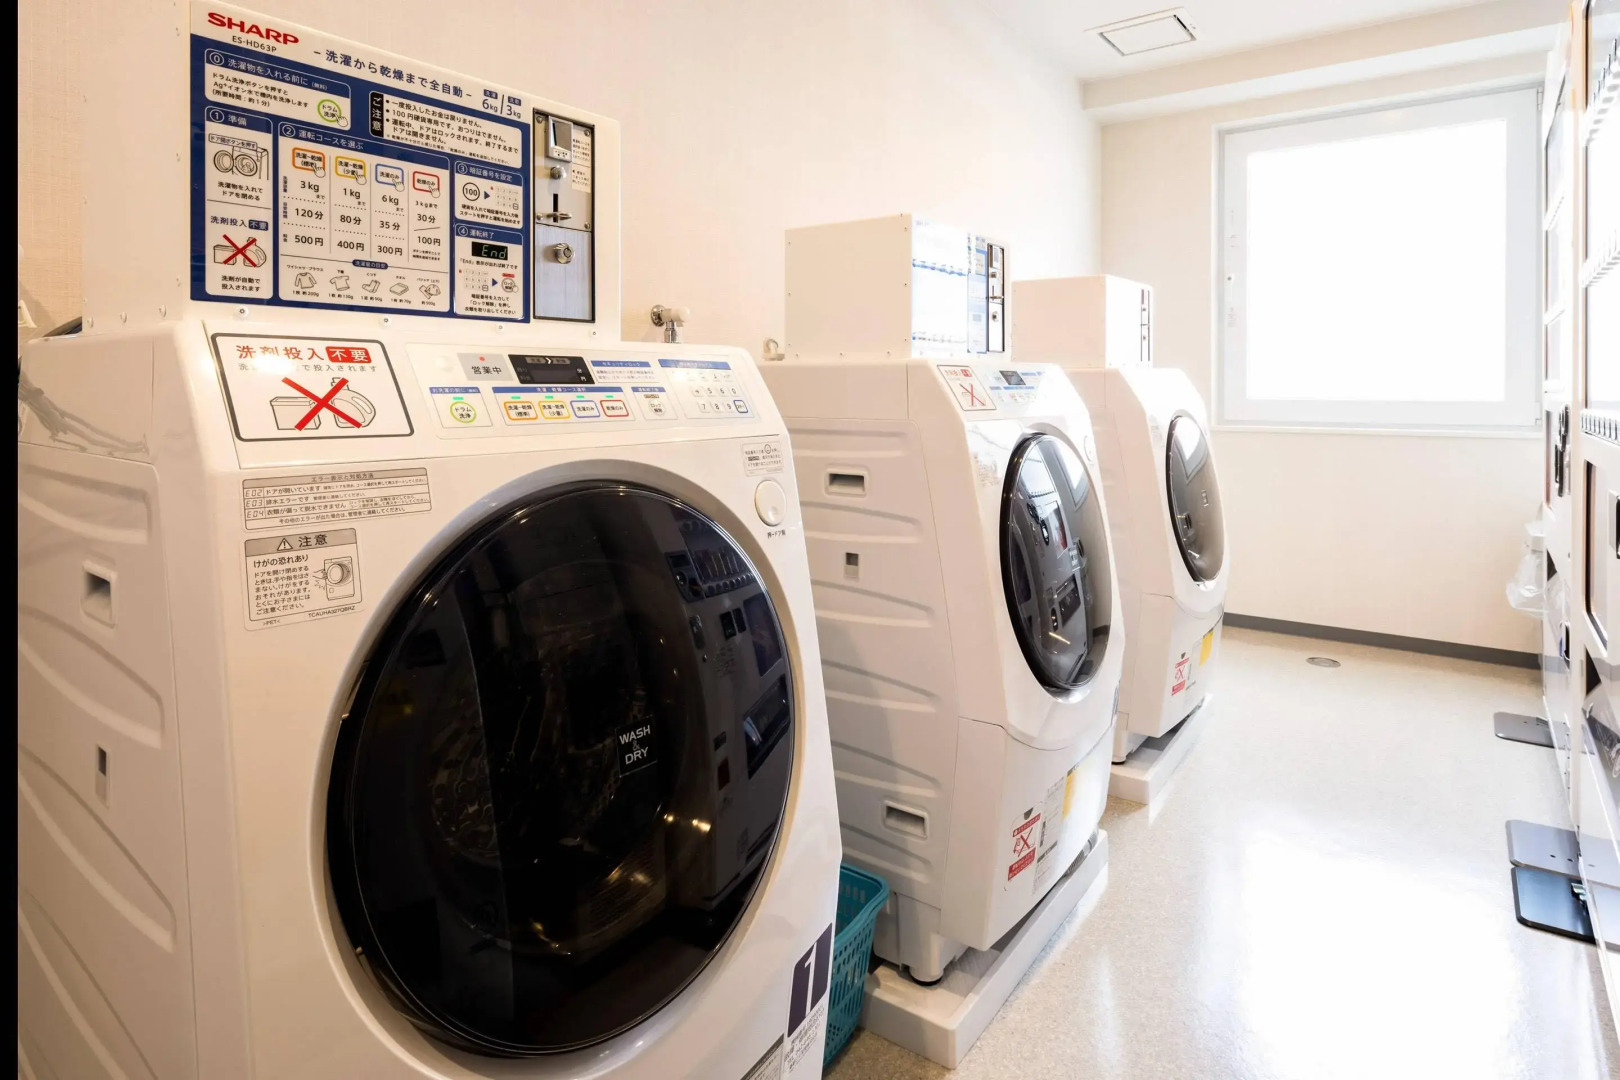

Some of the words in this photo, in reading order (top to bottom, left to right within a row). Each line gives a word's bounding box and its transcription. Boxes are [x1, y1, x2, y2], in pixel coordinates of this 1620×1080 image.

[208, 12, 299, 45] SHARP
[232, 35, 277, 53] ES-HD63P
[227, 58, 309, 85] 洗濯物を入れる前に
[482, 98, 498, 113] 6kg
[506, 105, 521, 119] 3kg
[228, 114, 247, 126] 準備
[298, 129, 364, 150] 運転コースを選ぶ
[469, 166, 513, 182] 暗証番号を設定
[218, 181, 263, 193] 洗濯物を入れて
[465, 187, 478, 196] 100
[222, 190, 261, 201] ドアを閉める
[295, 208, 324, 220] 120分
[340, 214, 362, 226] 80分
[210, 215, 247, 228] 洗剤投入
[294, 234, 324, 247] 500円
[337, 240, 365, 251] 400円
[417, 235, 441, 247] 100円
[377, 245, 403, 256] 300円
[481, 244, 507, 259] End
[221, 275, 261, 284] 洗剤が自動で
[221, 283, 261, 292] 投入されます
[330, 348, 369, 362] 不要
[471, 365, 502, 375] 営業中
[298, 533, 328, 548] 注意
[253, 554, 309, 568] けがの恐れあり
[619, 724, 651, 745] WASH
[625, 746, 649, 765] DRY
